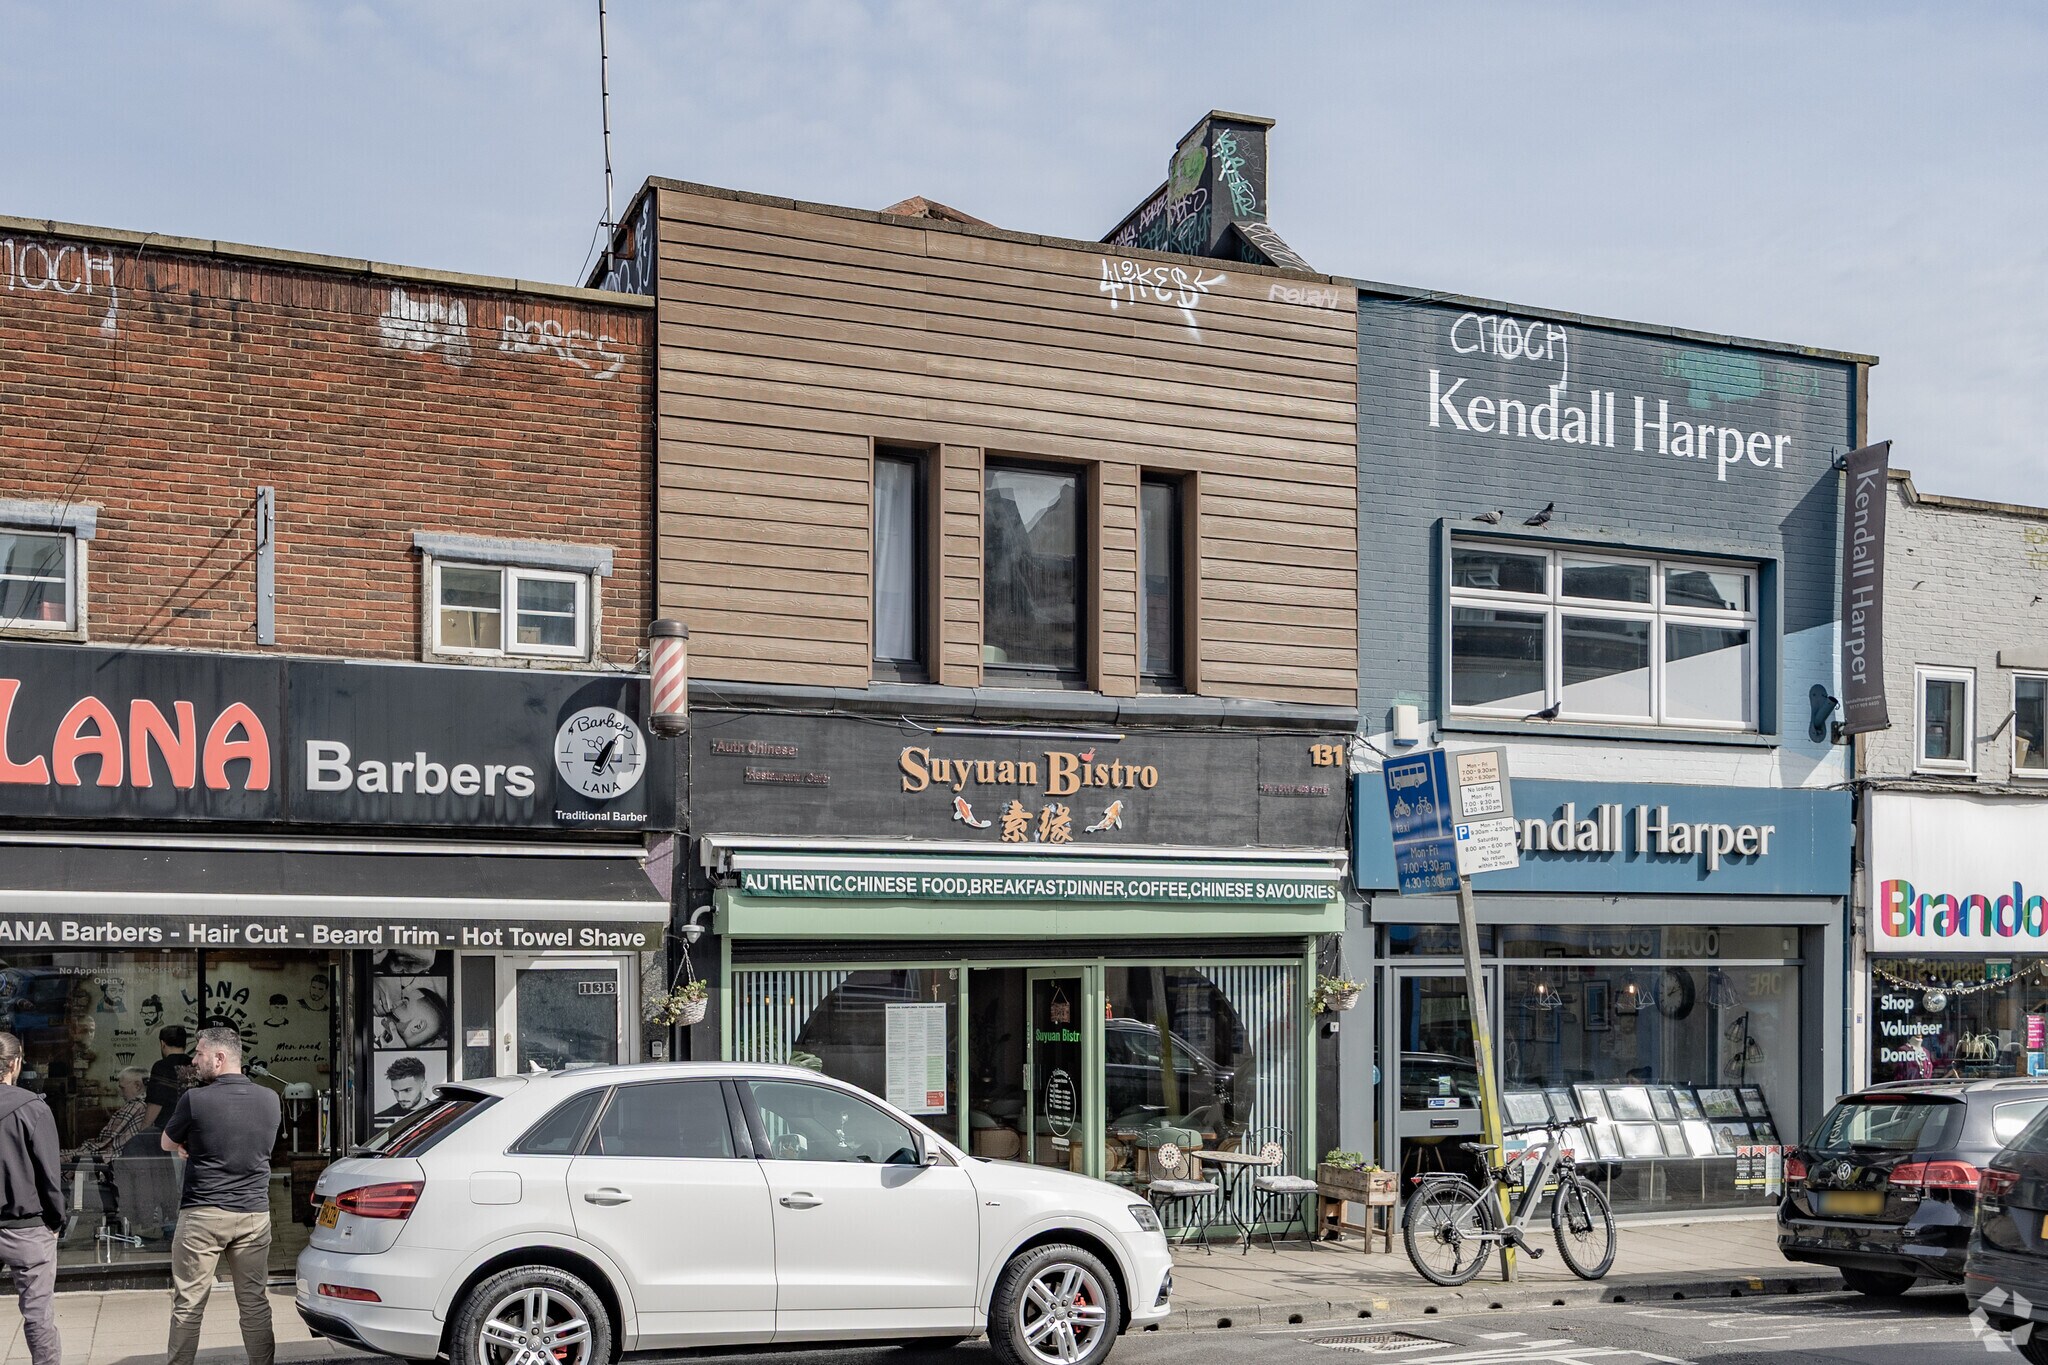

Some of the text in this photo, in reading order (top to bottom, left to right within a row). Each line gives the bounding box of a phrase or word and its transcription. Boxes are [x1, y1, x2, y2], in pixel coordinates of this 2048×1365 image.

[1428, 369, 1791, 481] Kendall Harper
[1845, 468, 1879, 684] Kendall Harper
[578, 713, 629, 732] Barber
[0, 678, 271, 790] LANA
[716, 740, 796, 756] Auth Chinese
[1310, 744, 1343, 766] 131
[306, 739, 536, 798] Barbers
[900, 747, 1159, 796] Suyuan Bistro
[582, 780, 622, 794] LANA
[555, 810, 648, 822] Traditional Barber
[1002, 800, 1073, 844] 素缘
[1396, 821, 1410, 833] taxi
[1514, 802, 1776, 871] ndall Harper
[844, 875, 917, 893] CHINESE
[1256, 883, 1336, 900] SAVOURIES
[1881, 879, 2048, 938] Brando
[61, 921, 163, 942] Barbers
[188, 923, 239, 943] Hair
[245, 924, 288, 944] Cut
[312, 925, 382, 944] Beard
[389, 925, 439, 945] Trim
[463, 927, 503, 946] Hot
[509, 927, 572, 946] Towel
[579, 928, 646, 947] Shave
[1611, 930, 1652, 956] 909
[59, 967, 72, 975] No
[94, 976, 118, 986] Open
[580, 982, 616, 995] 133
[1881, 994, 1914, 1014] Shop
[1036, 1028, 1081, 1043] Suyuan Bistr
[1880, 1019, 1942, 1036] Volunteer
[1881, 1047, 1926, 1063] Donate
